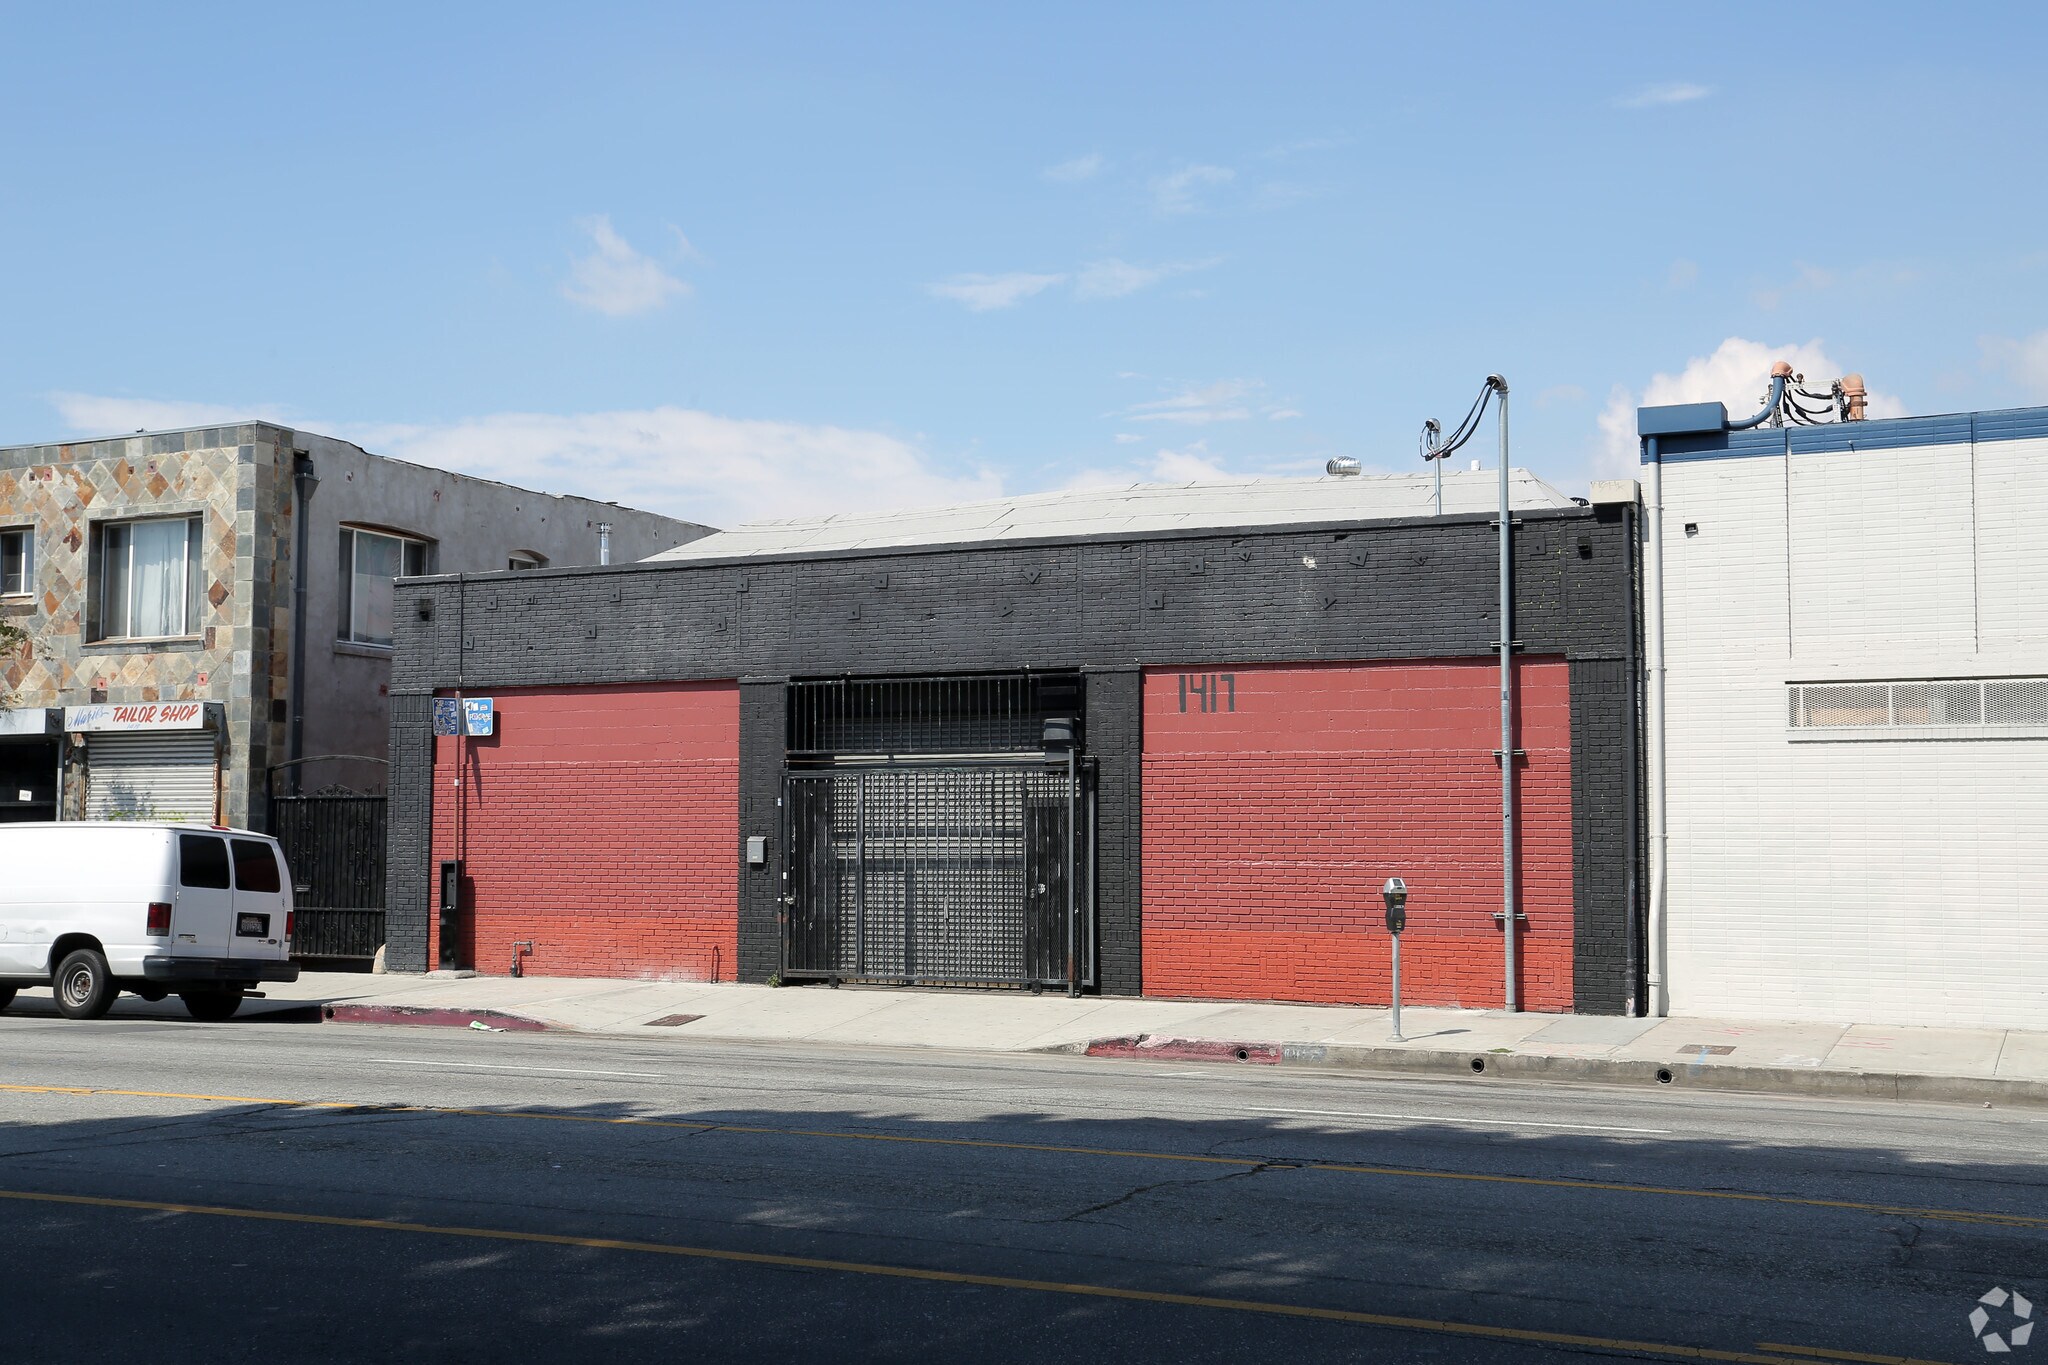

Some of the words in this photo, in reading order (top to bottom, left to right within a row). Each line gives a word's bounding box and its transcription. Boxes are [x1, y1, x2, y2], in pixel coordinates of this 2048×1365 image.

[1179, 674, 1234, 713] 1417
[112, 705, 157, 723] TAILOR
[159, 703, 199, 722] SHOP
